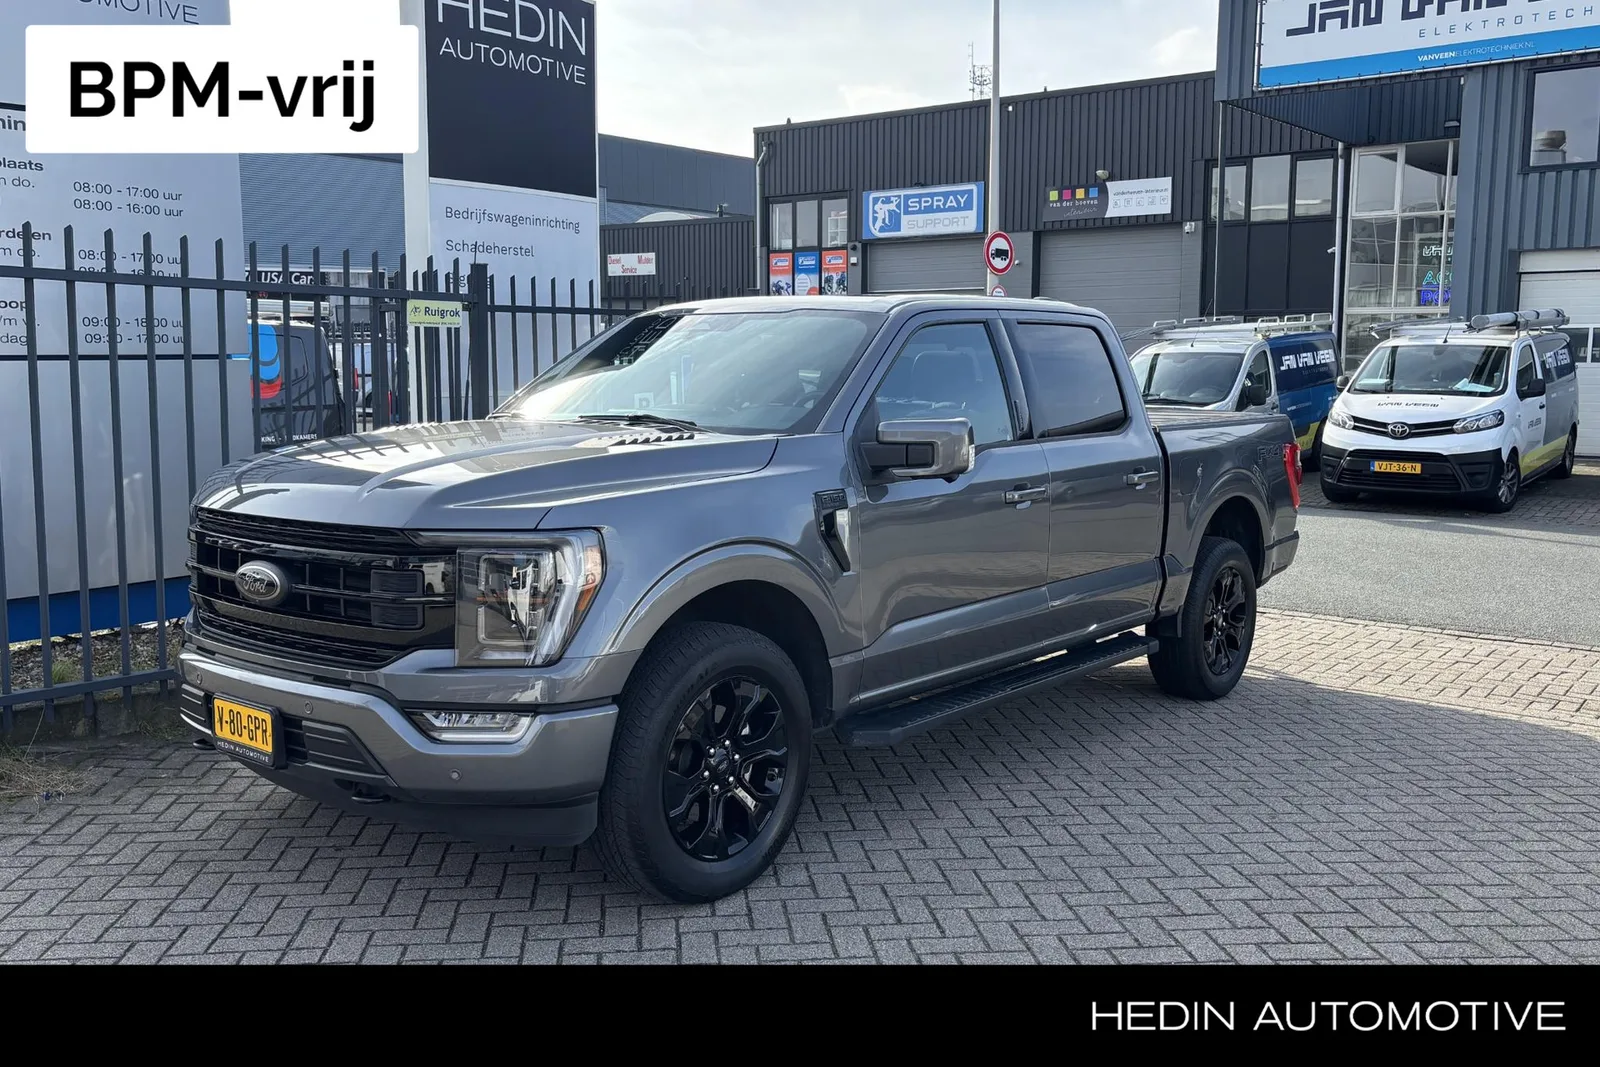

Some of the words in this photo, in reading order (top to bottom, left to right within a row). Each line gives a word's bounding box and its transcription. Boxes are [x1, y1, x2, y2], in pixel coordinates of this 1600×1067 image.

[438, 0, 587, 56] HEDIN
[439, 37, 587, 86] AUTOMOTIVE
[0, 157, 44, 172] laats
[11, 176, 35, 189] do.
[73, 181, 113, 195] 08:00
[126, 186, 160, 199] 17:00
[163, 191, 183, 201] uur
[73, 198, 113, 212] 08:00
[126, 203, 161, 216] 16:00
[164, 208, 184, 217] uur
[907, 193, 969, 212] SPRAY
[445, 206, 581, 234] Bedrijfswageninrichting
[907, 216, 970, 230] SUPPORT
[445, 239, 535, 258] Schadeherstel
[131, 253, 164, 265] 1700
[167, 256, 182, 265] uu
[291, 272, 315, 285] Car
[424, 306, 461, 319] Ruigrok
[134, 318, 168, 328] 1800
[84, 333, 123, 344] 09:0
[136, 334, 169, 344] 1700
[1377, 462, 1417, 473] VJT-36-N
[242, 572, 268, 593] Ford
[216, 705, 269, 747] V-80-GPR
[217, 741, 234, 750] HEDIN
[235, 746, 270, 763] AUTOMOTIVE
